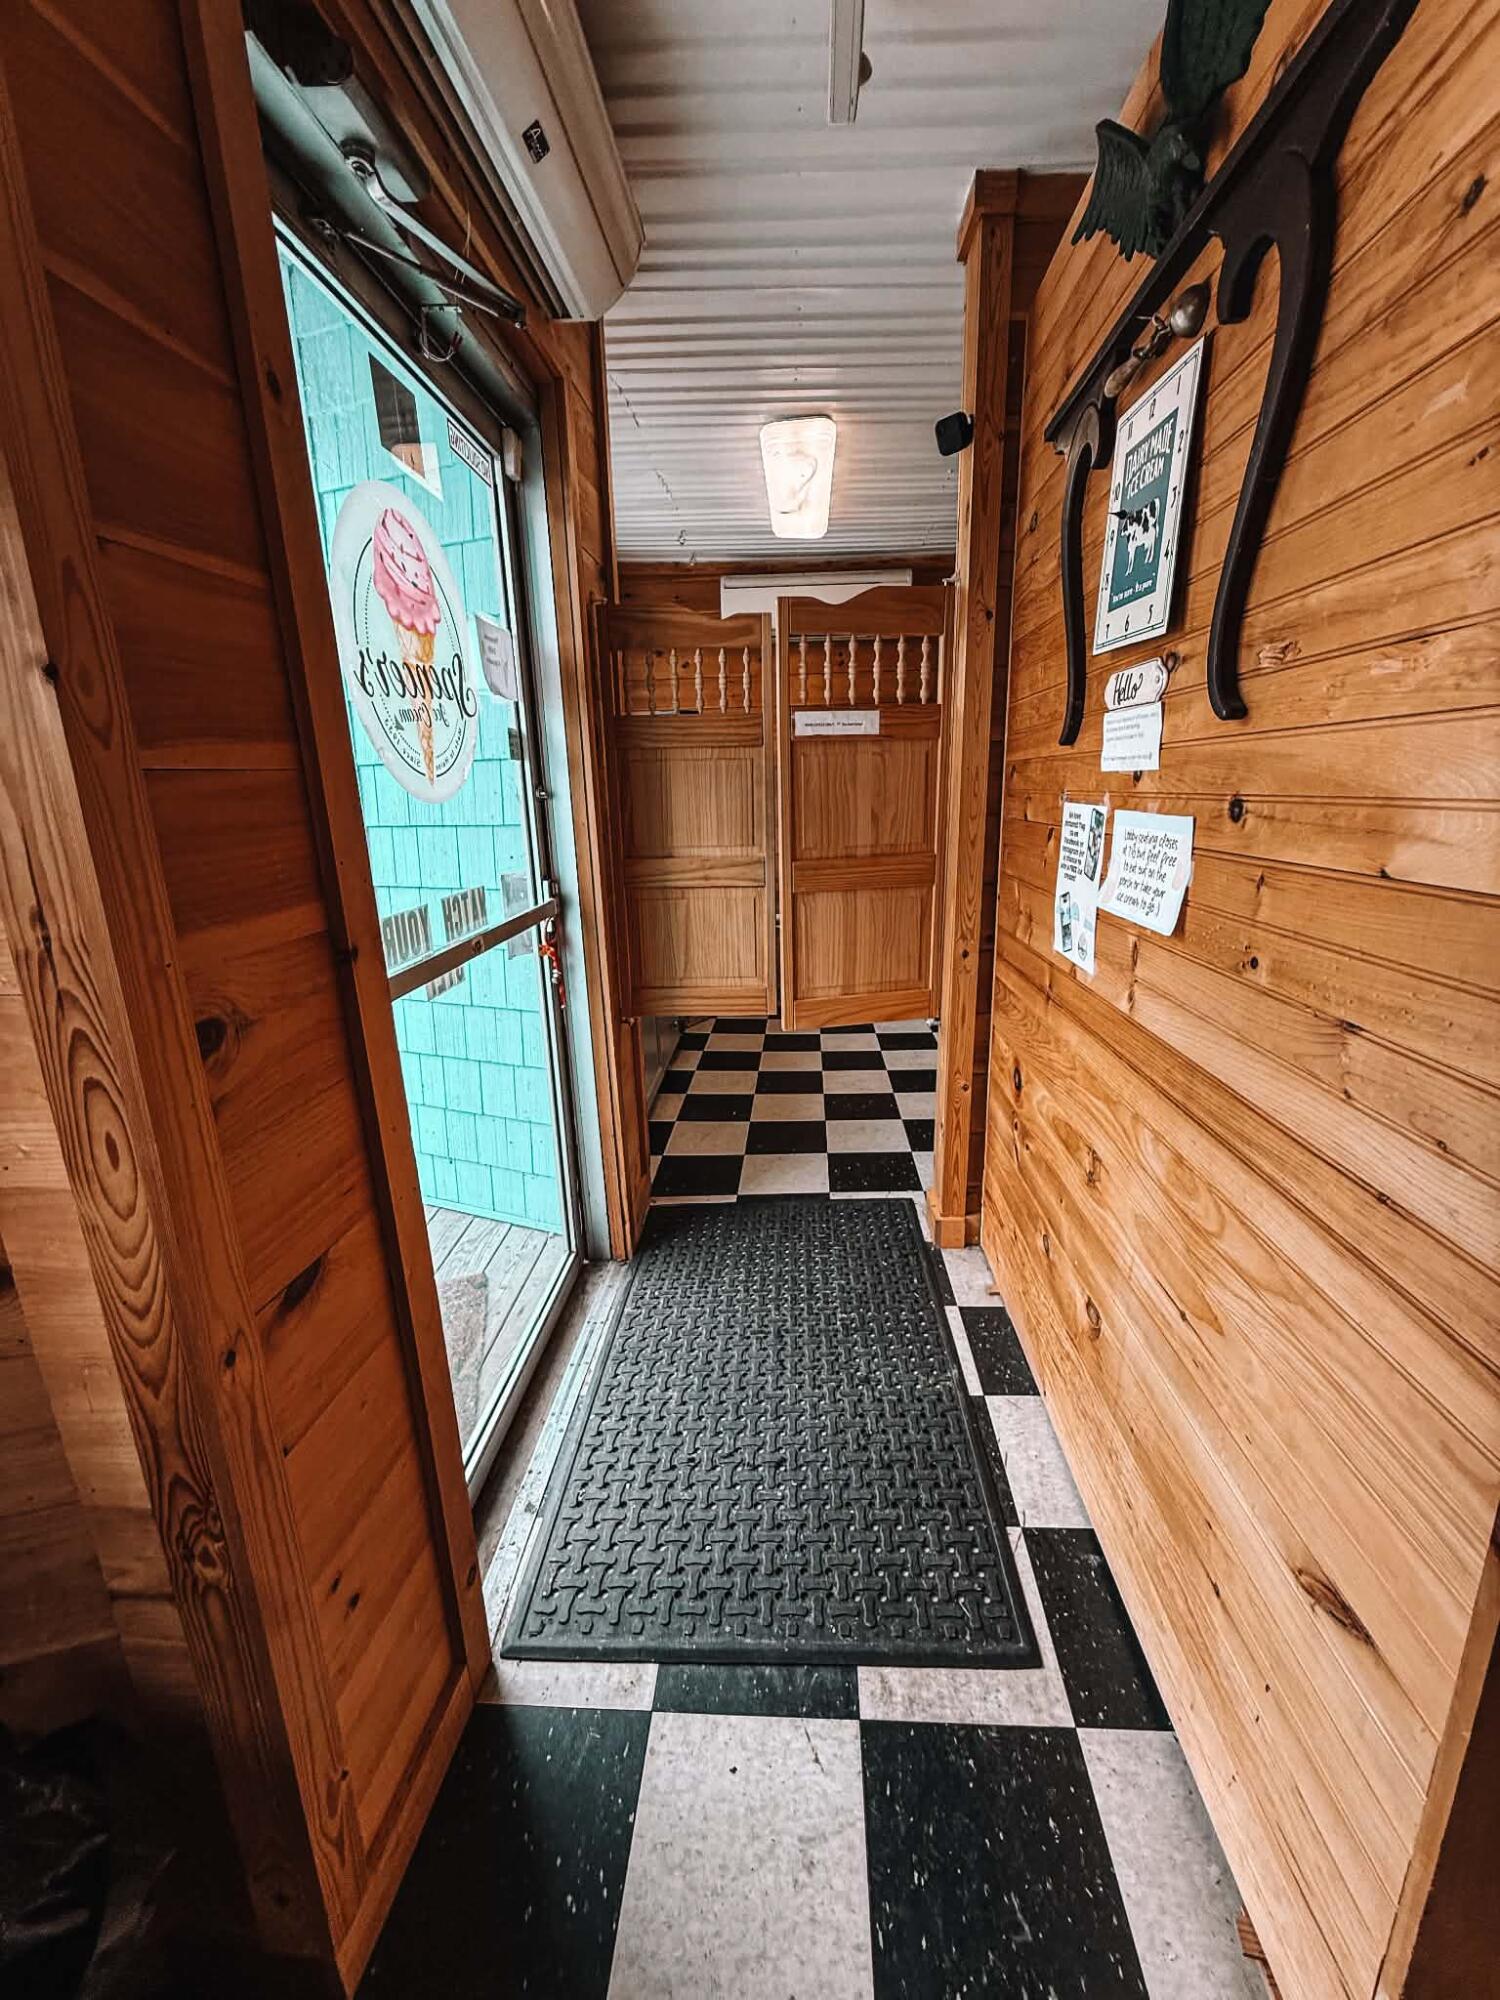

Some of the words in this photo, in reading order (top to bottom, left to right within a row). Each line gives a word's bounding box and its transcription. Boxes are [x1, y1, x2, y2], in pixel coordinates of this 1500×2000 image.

[1125, 438, 1151, 487] DAIRY
[1149, 418, 1174, 458] MADE
[1126, 473, 1139, 500] ICE
[1139, 456, 1166, 491] CREAM
[1112, 672, 1144, 706] Hello
